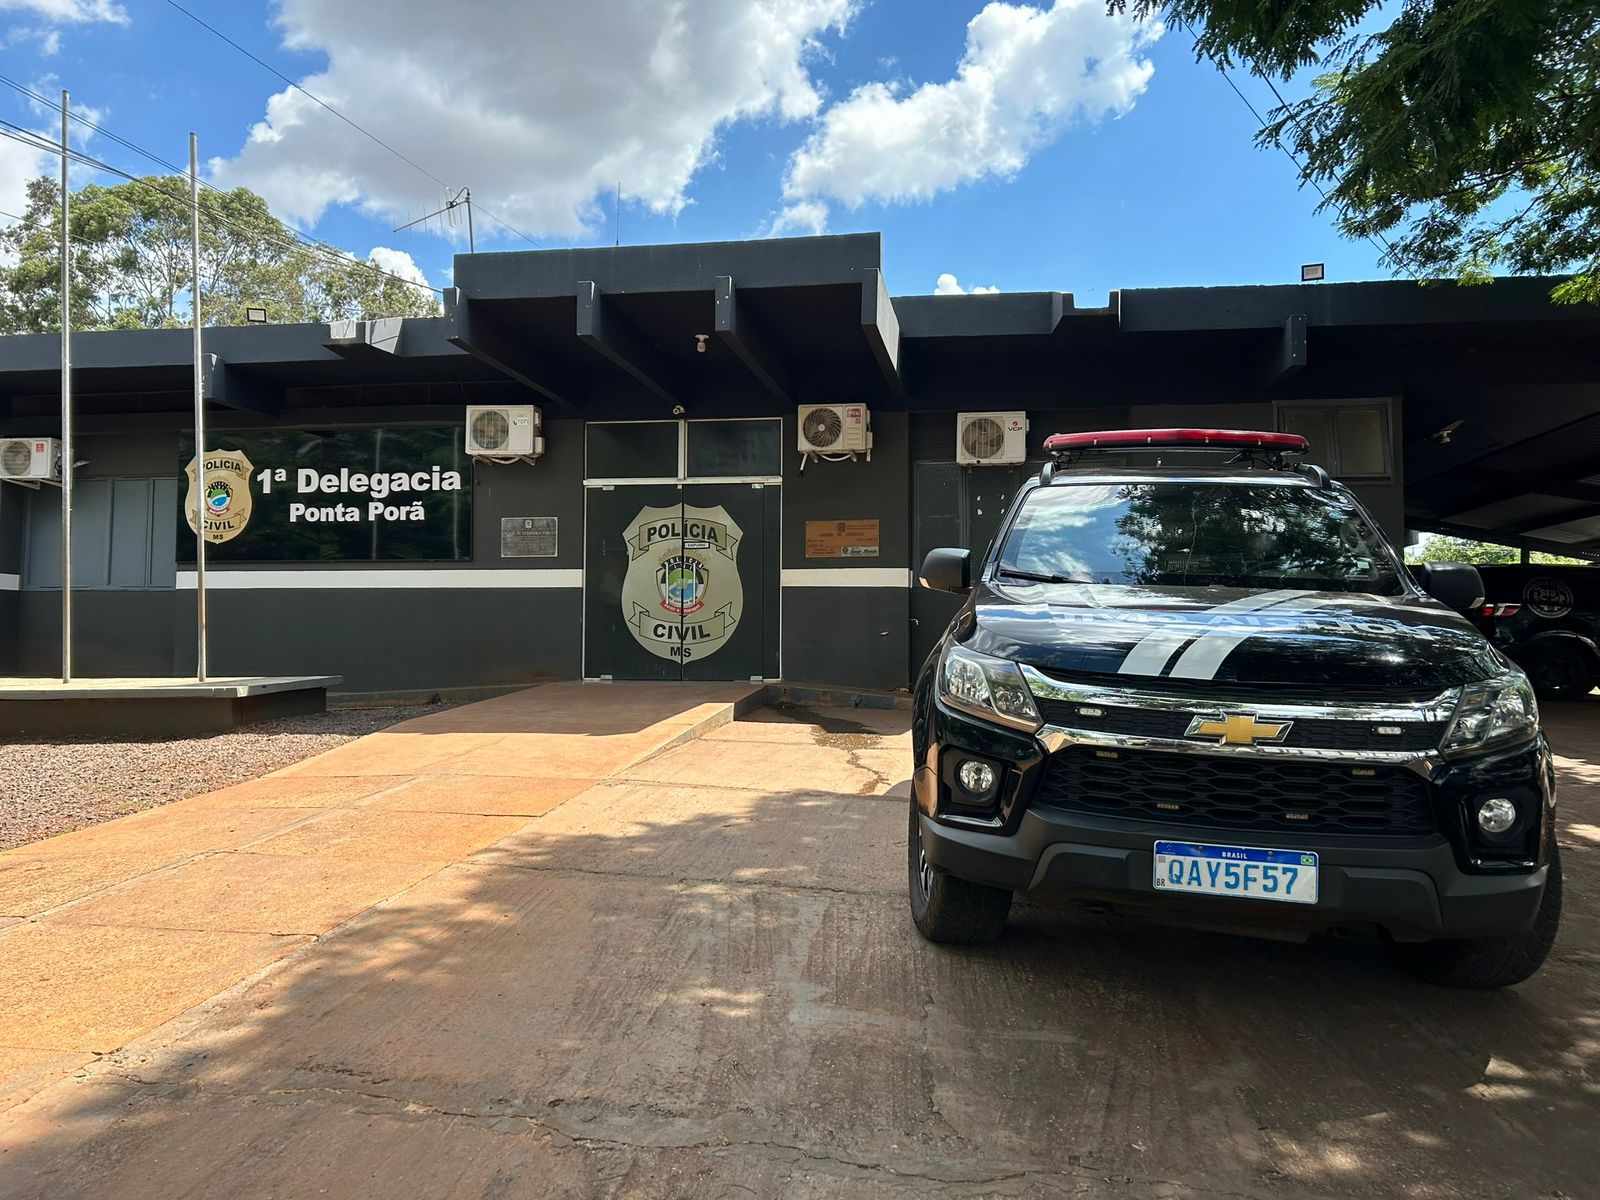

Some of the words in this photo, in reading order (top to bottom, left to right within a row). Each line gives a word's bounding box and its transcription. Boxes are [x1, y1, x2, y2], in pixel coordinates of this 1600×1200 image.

[256, 468, 287, 494] 1ª
[297, 466, 461, 499] Delegacia
[289, 503, 360, 523] Ponta
[368, 501, 425, 521] Porã
[647, 520, 719, 543] POLÍCIA
[652, 623, 711, 641] CIVIL
[670, 646, 692, 658] MS
[1221, 851, 1248, 860] BRASIL
[1156, 878, 1166, 887] BR
[1168, 859, 1298, 895] QAY5F57
